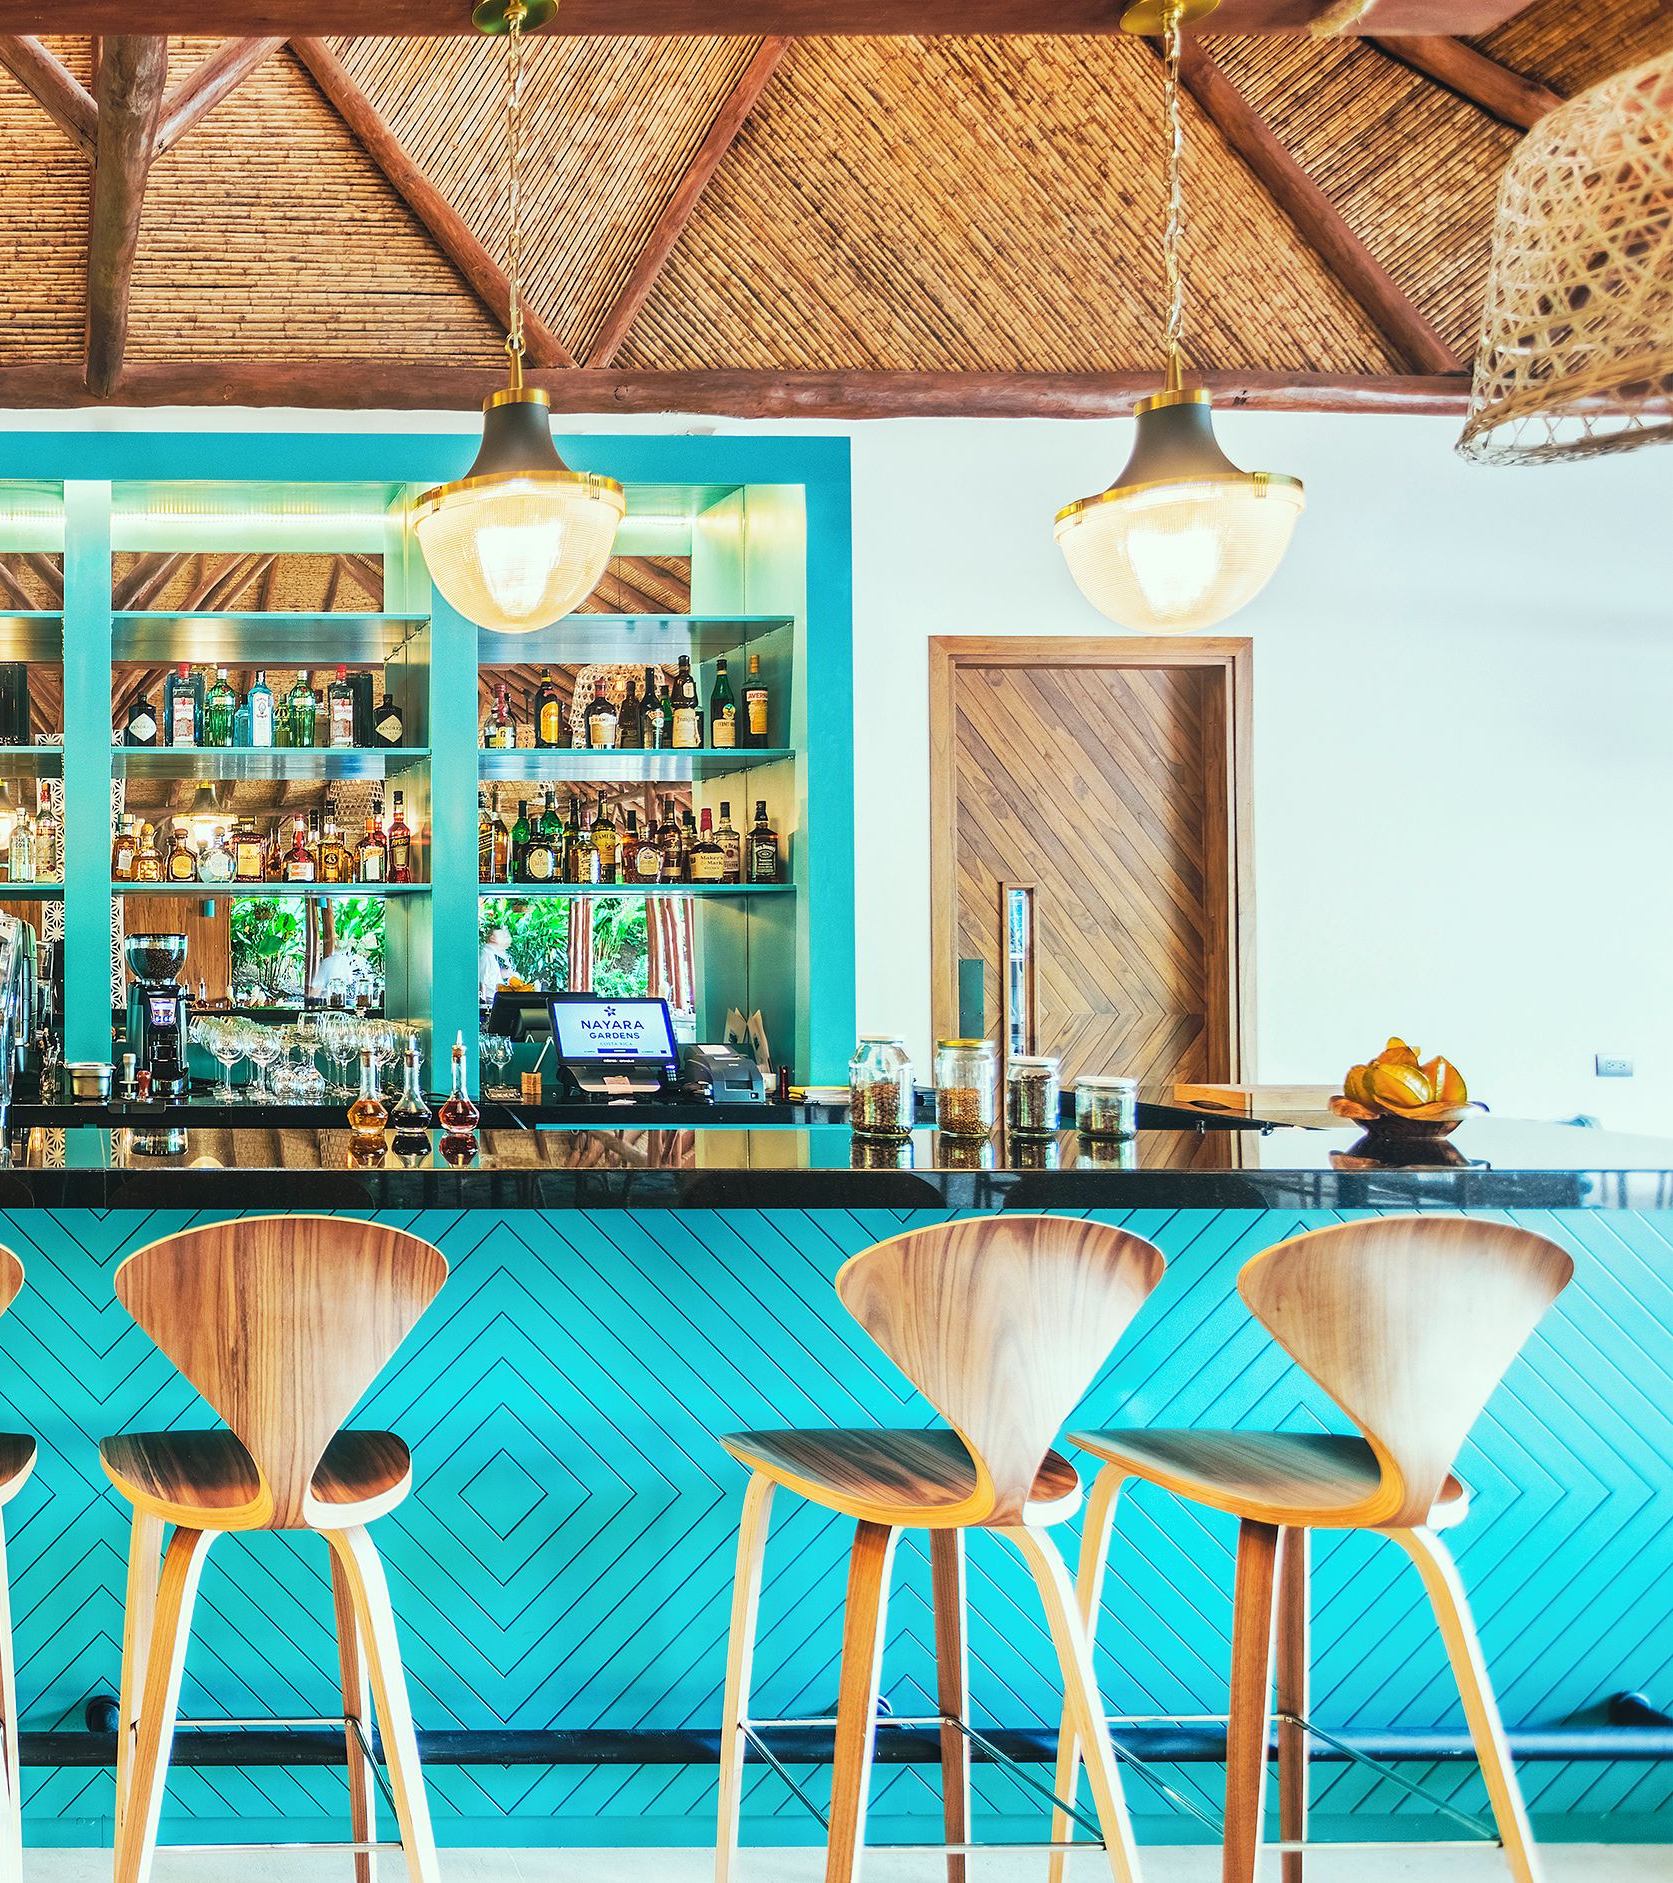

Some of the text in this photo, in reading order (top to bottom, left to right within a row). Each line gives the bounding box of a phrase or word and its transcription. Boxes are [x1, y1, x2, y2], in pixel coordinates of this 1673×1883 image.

[326, 853, 337, 864] 43
[581, 1020, 645, 1030] NAYARA
[589, 1032, 641, 1040] GARDENS
